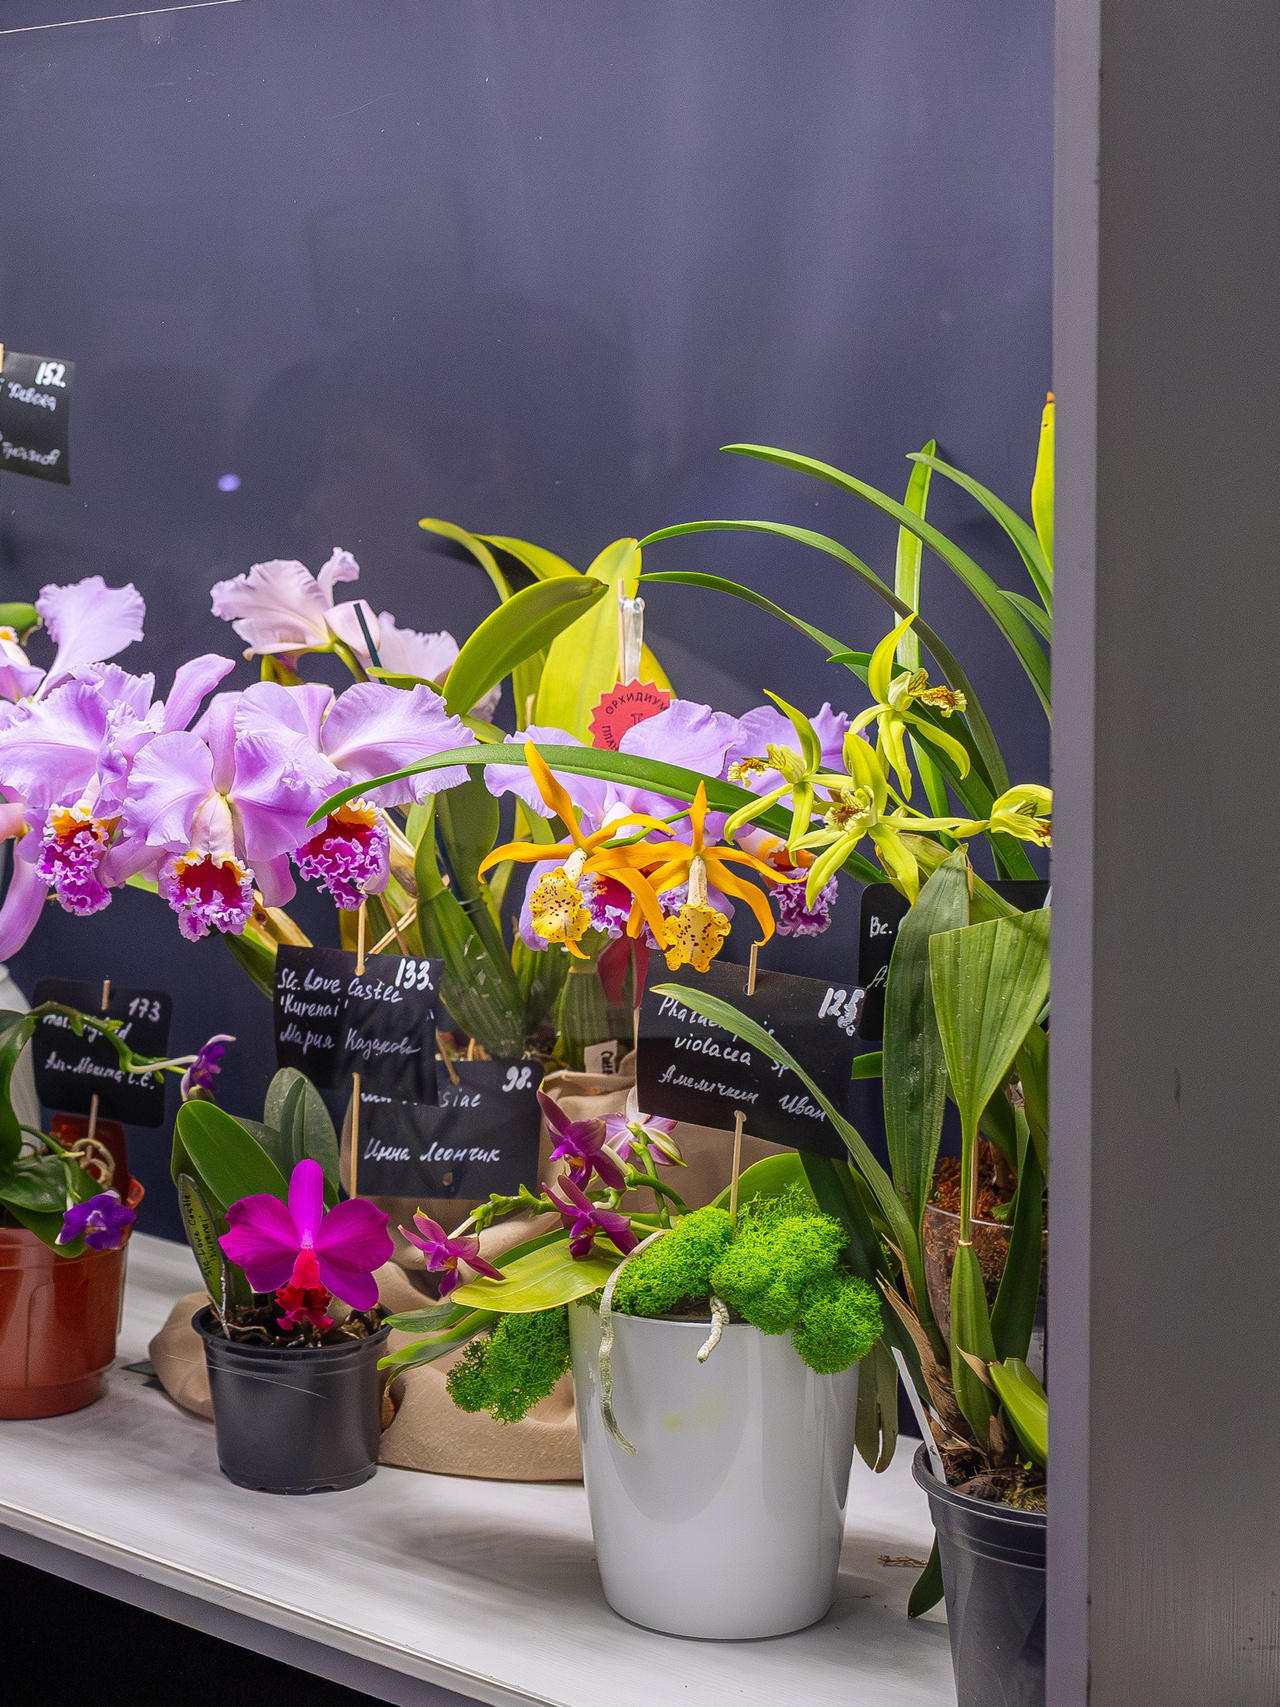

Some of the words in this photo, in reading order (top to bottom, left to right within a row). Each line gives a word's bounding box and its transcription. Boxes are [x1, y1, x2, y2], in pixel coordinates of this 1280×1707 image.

[34, 361, 67, 388] 152.
[870, 914, 893, 939] Bc.
[303, 967, 342, 994] Love
[347, 977, 403, 1004] Castle
[394, 957, 435, 992] 133.
[128, 997, 161, 1022] 173
[279, 1022, 335, 1055] Мария
[674, 1032, 752, 1067] violacea
[502, 1065, 533, 1093] 98.
[778, 1093, 827, 1122] Иван
[363, 1137, 411, 1162] Инна
